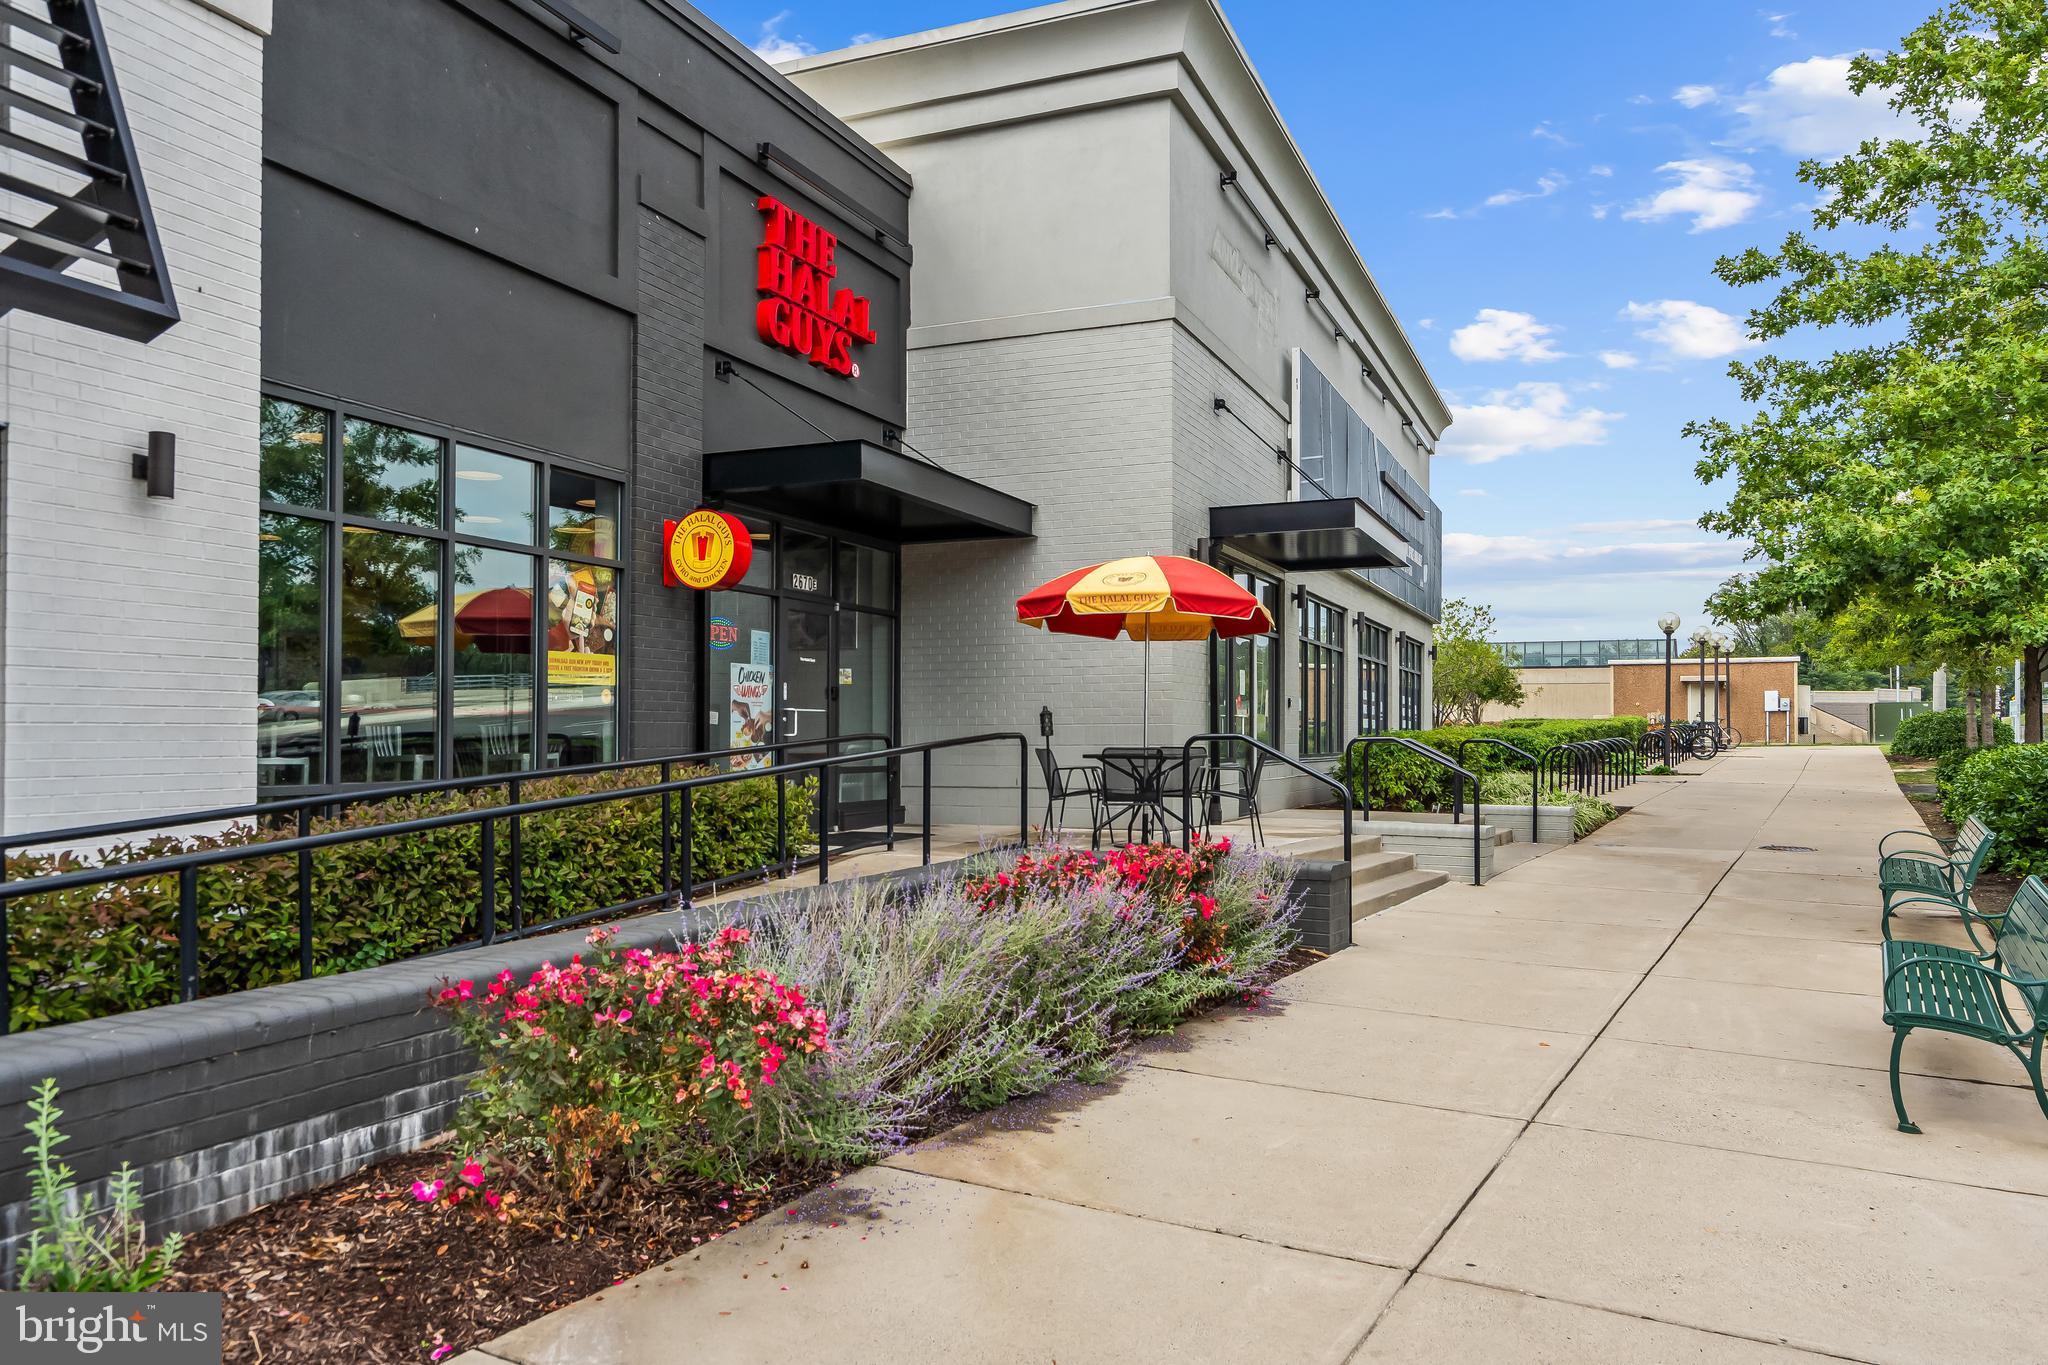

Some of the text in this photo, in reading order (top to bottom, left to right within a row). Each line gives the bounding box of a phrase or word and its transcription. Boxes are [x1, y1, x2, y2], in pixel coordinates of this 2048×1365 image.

[758, 195, 838, 278] THE
[757, 245, 876, 344] HALAL
[757, 297, 852, 376] GUYS
[673, 513, 732, 546] THE HALAL GUYS
[702, 558, 729, 583] CHICKEN
[1100, 594, 1132, 604] HALAL
[1133, 593, 1159, 602] GUYS
[709, 625, 738, 642] PEN
